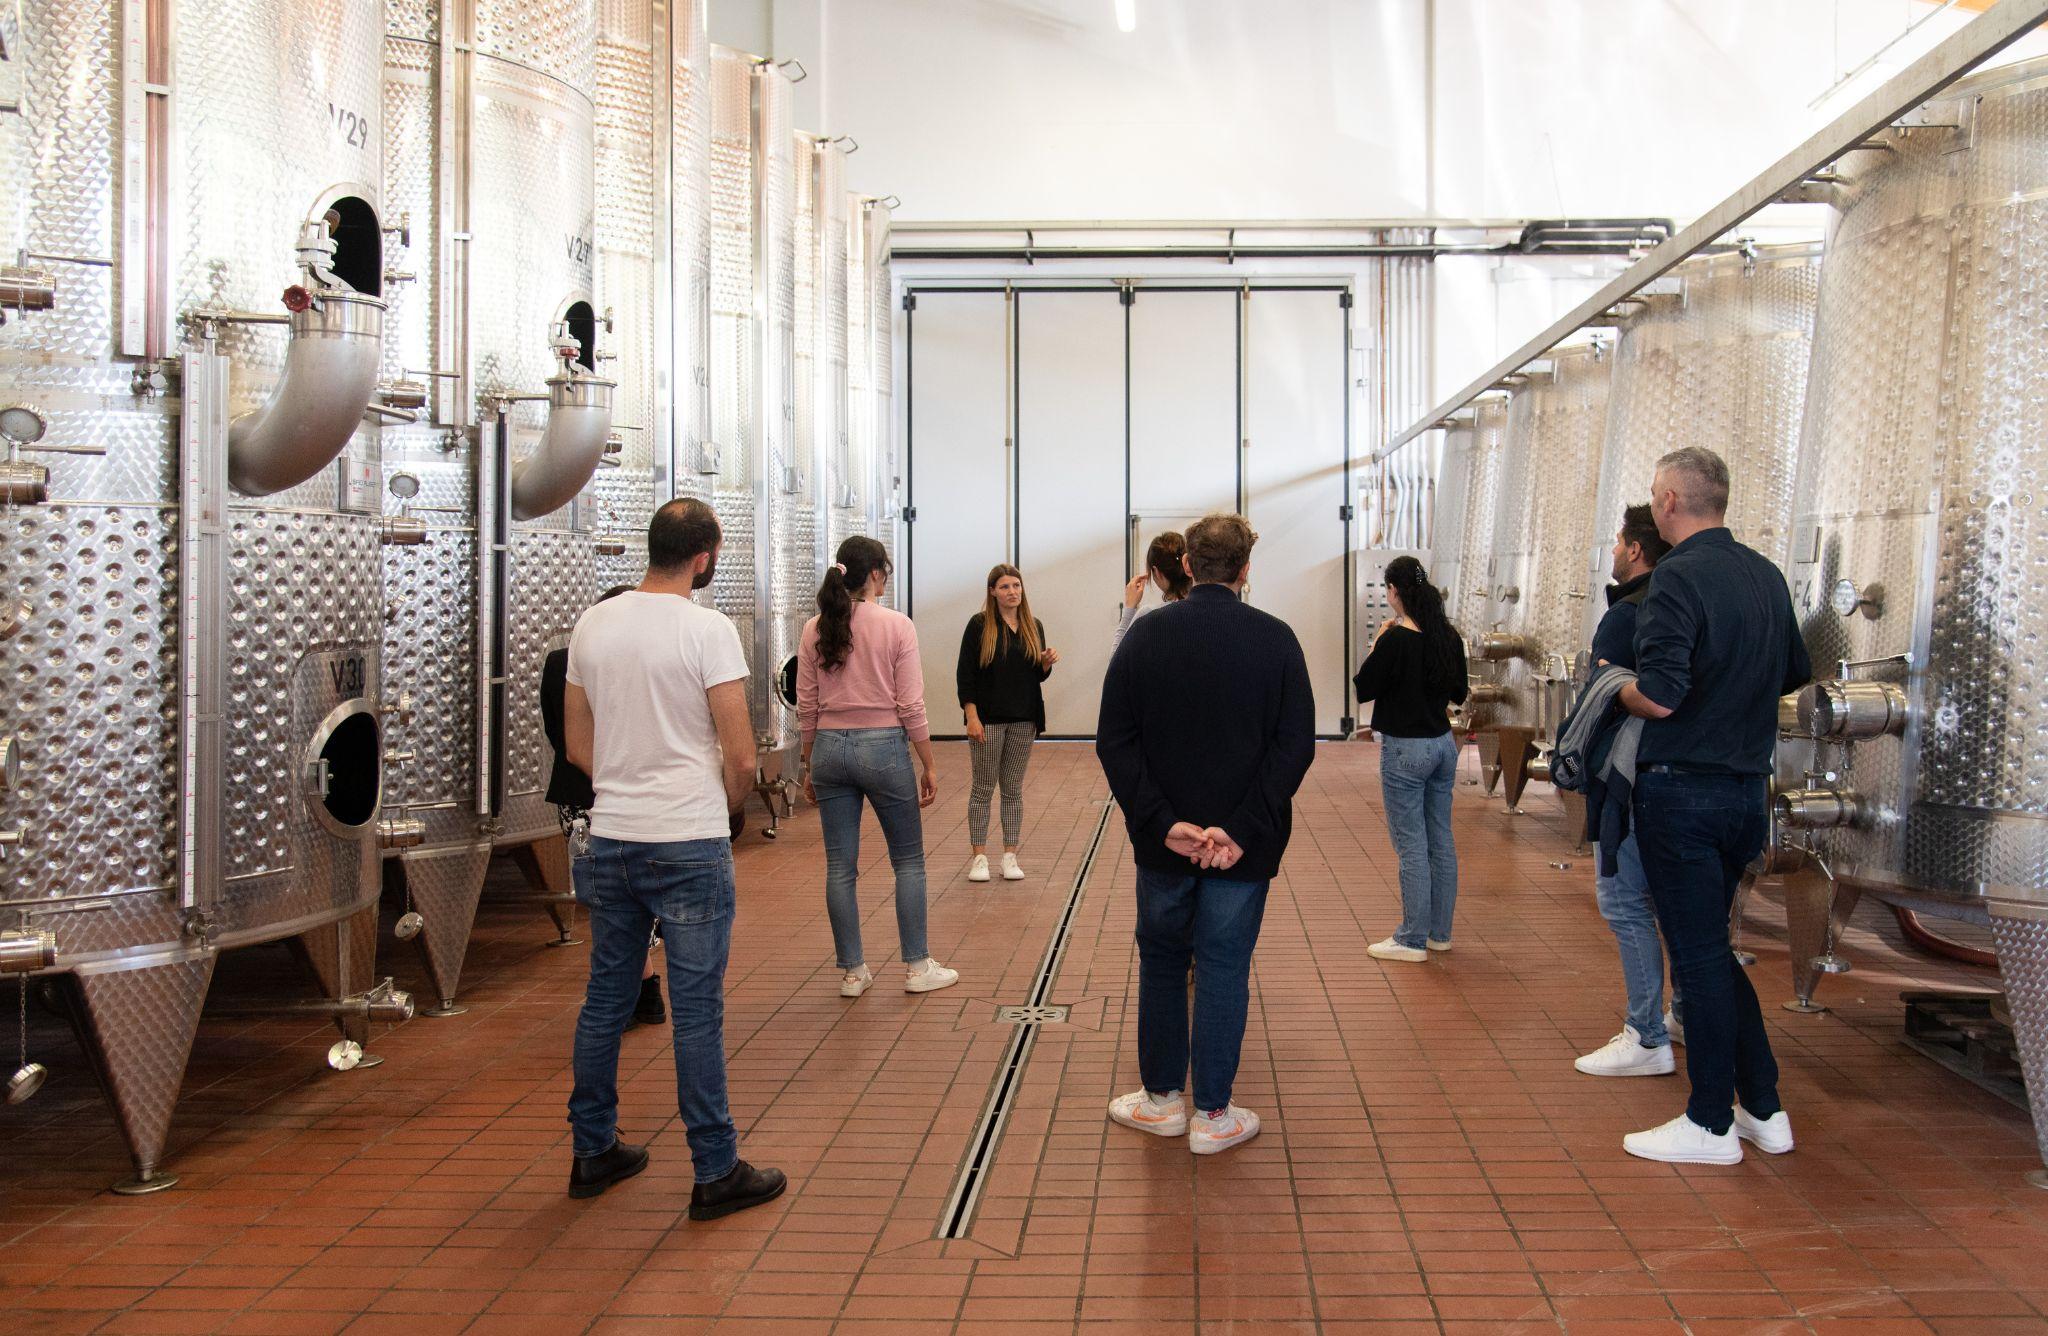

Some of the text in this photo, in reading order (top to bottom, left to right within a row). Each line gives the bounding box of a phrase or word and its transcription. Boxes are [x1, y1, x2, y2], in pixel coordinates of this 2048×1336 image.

[329, 102, 368, 150] V29
[1793, 579, 1812, 612] F4
[329, 656, 367, 694] V30
